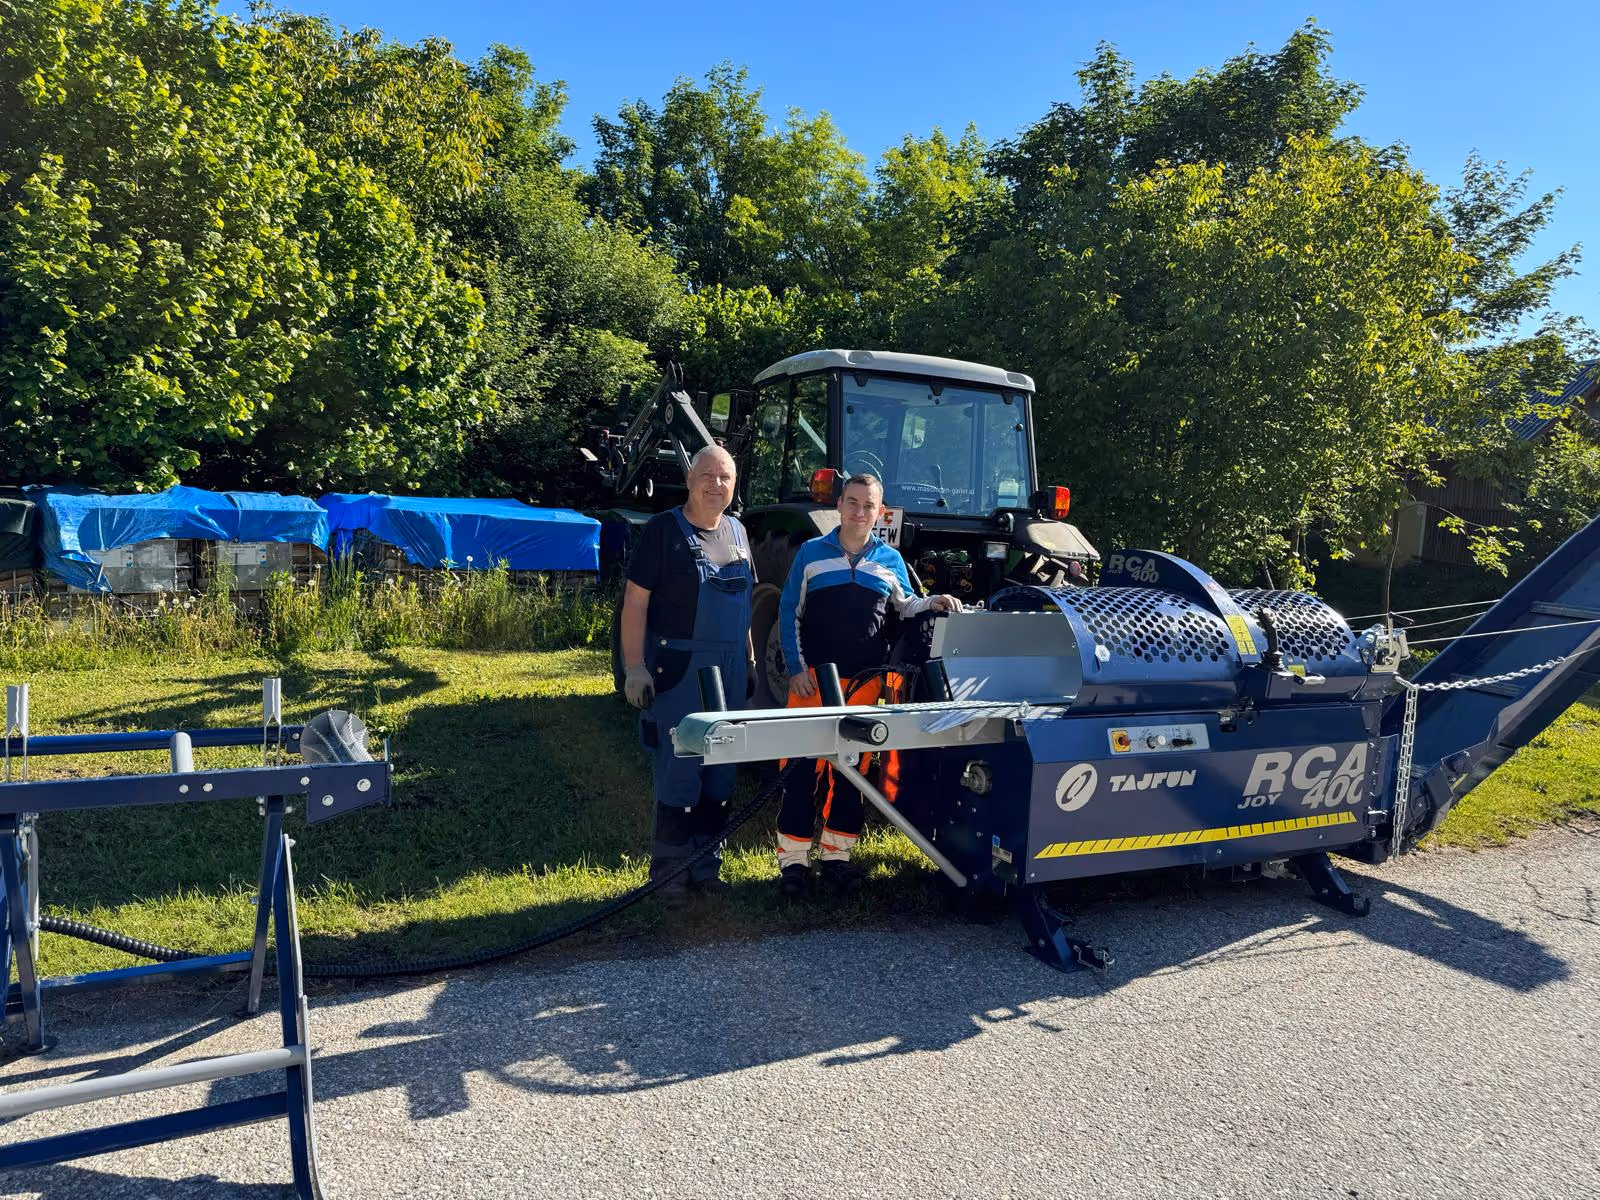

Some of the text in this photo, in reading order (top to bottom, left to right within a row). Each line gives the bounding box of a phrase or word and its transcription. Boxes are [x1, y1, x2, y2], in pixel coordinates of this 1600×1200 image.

[1108, 554, 1156, 573] RCA
[1131, 570, 1160, 584] 400
[1242, 742, 1368, 797] RCA
[1109, 769, 1197, 792] TAJFUN
[1237, 792, 1282, 809] JOY
